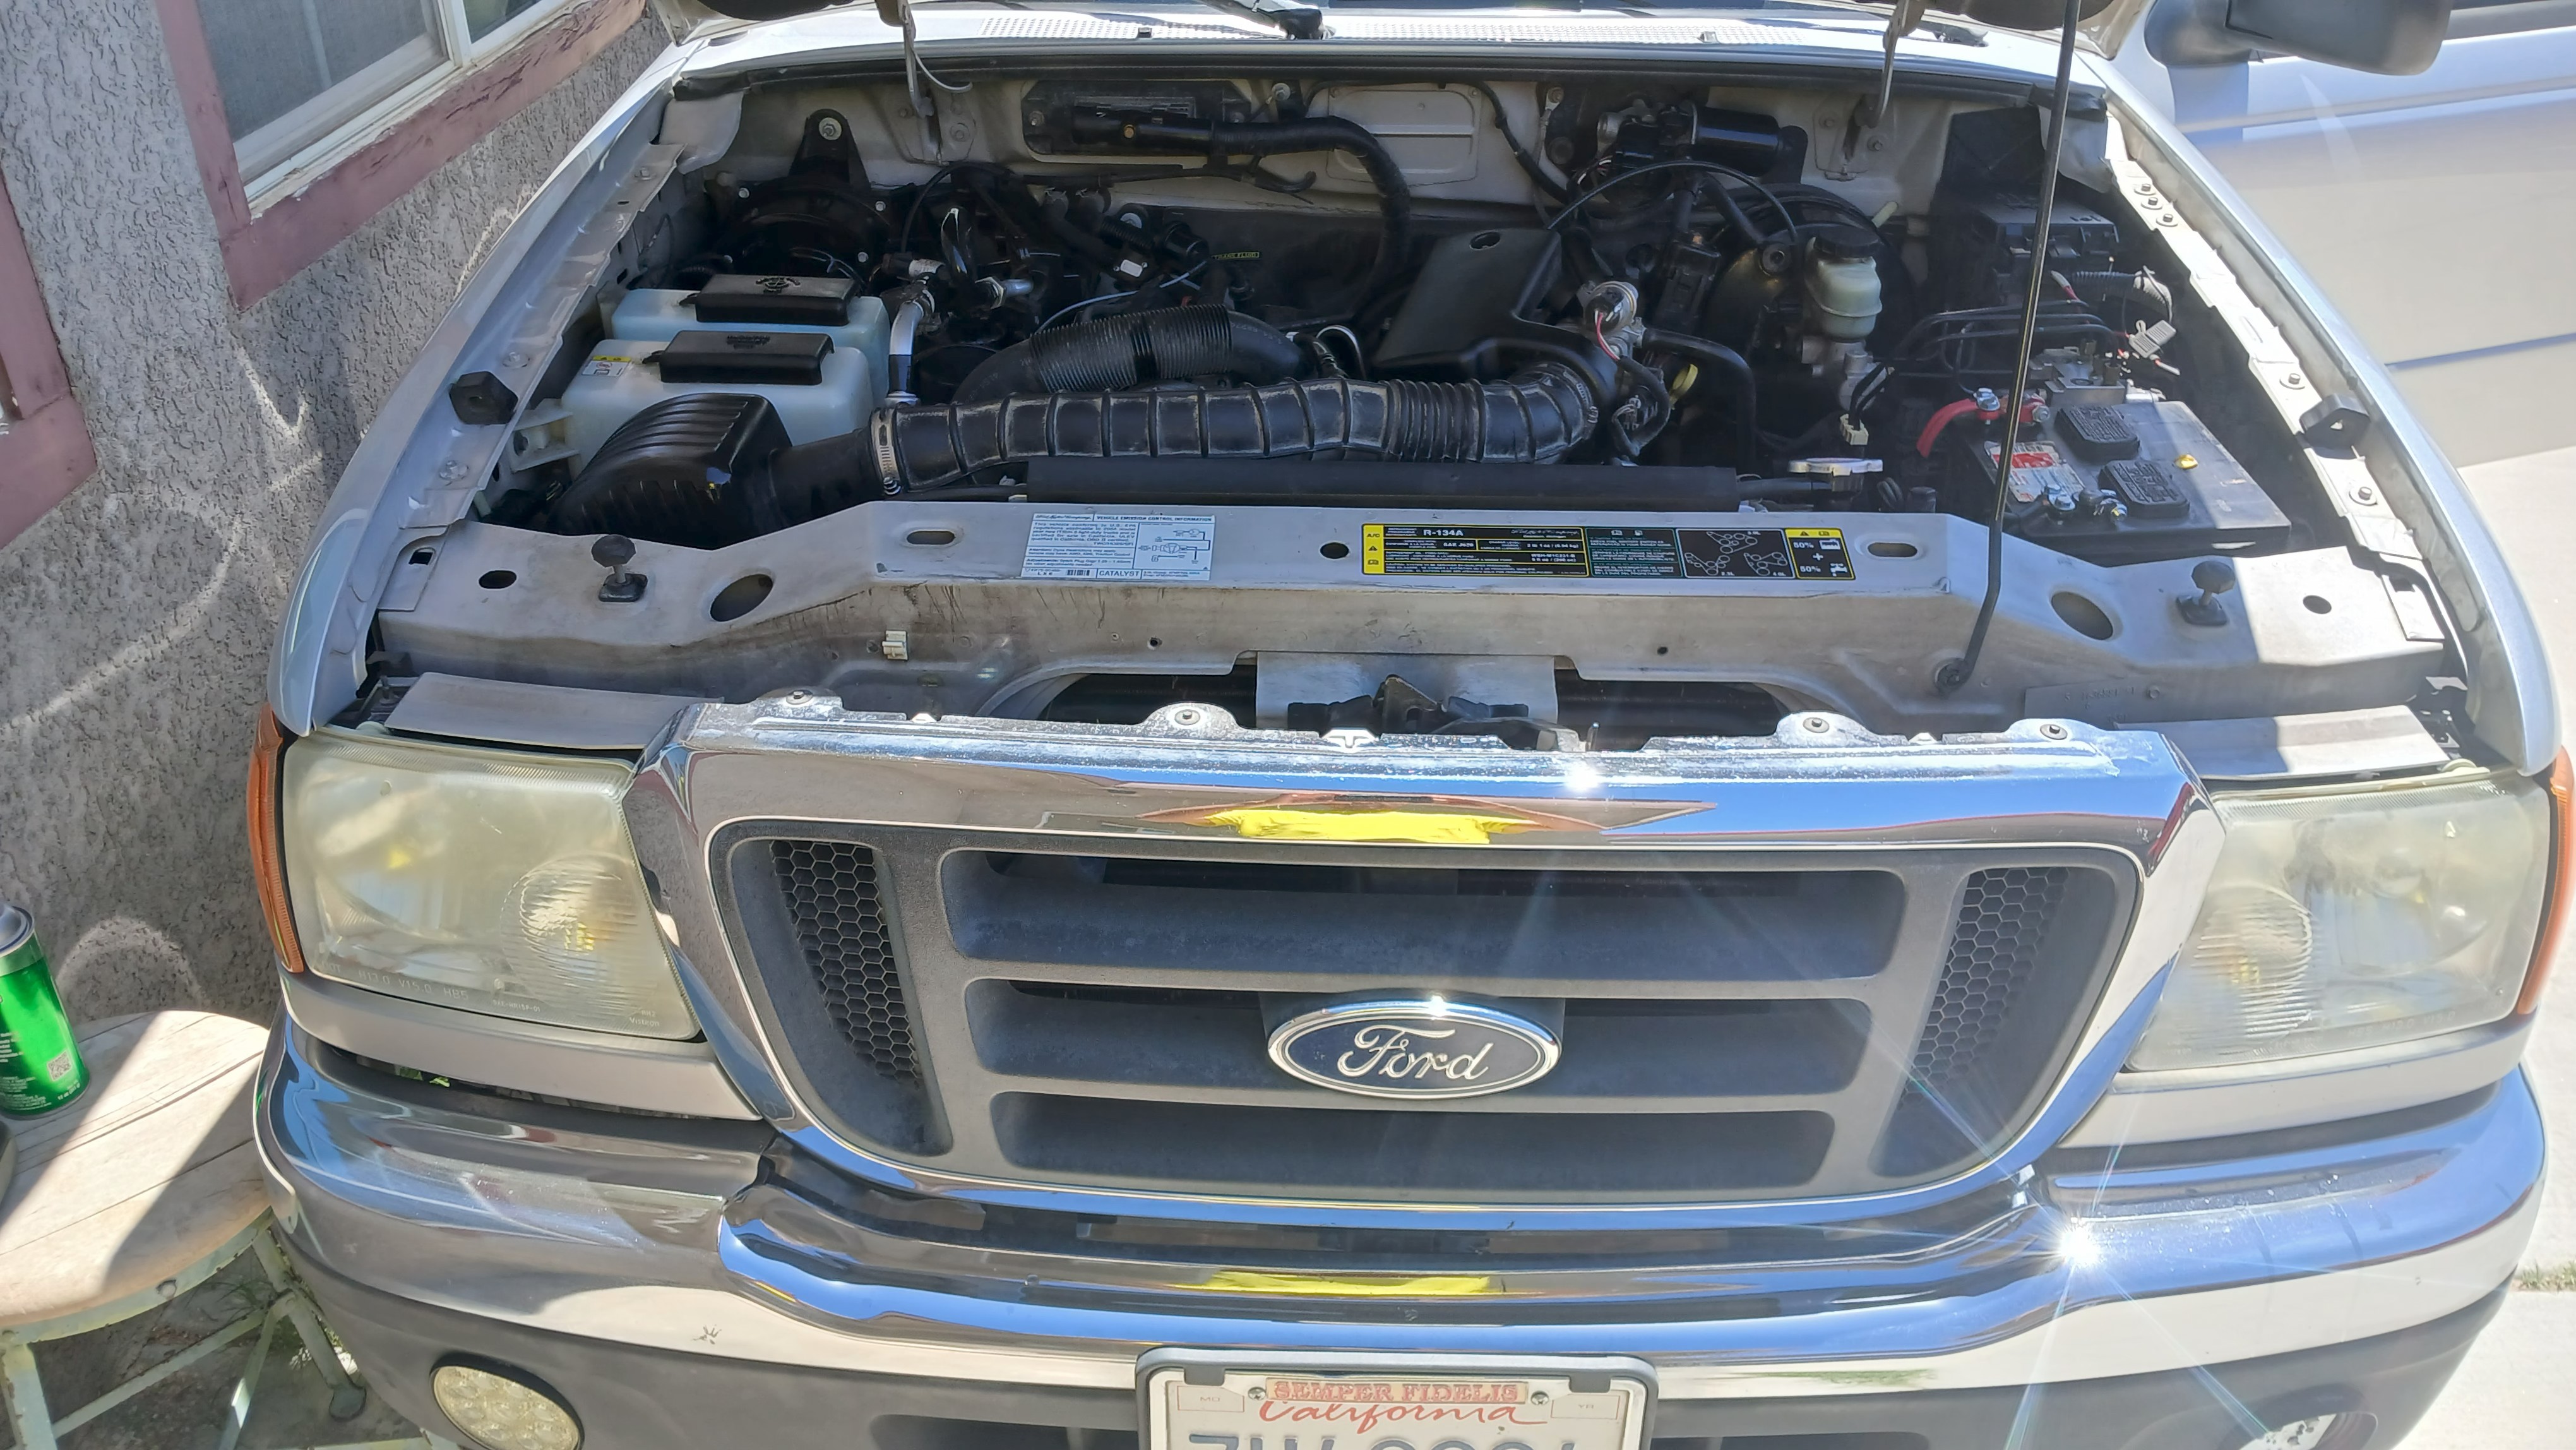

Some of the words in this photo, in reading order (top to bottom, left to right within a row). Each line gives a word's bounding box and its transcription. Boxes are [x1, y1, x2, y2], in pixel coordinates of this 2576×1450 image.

[1337, 1024, 1494, 1081] Ford
[1273, 1381, 1394, 1401] SEMPER
[1401, 1382, 1518, 1403] FIDELIS
[1258, 1400, 1548, 1435] California
